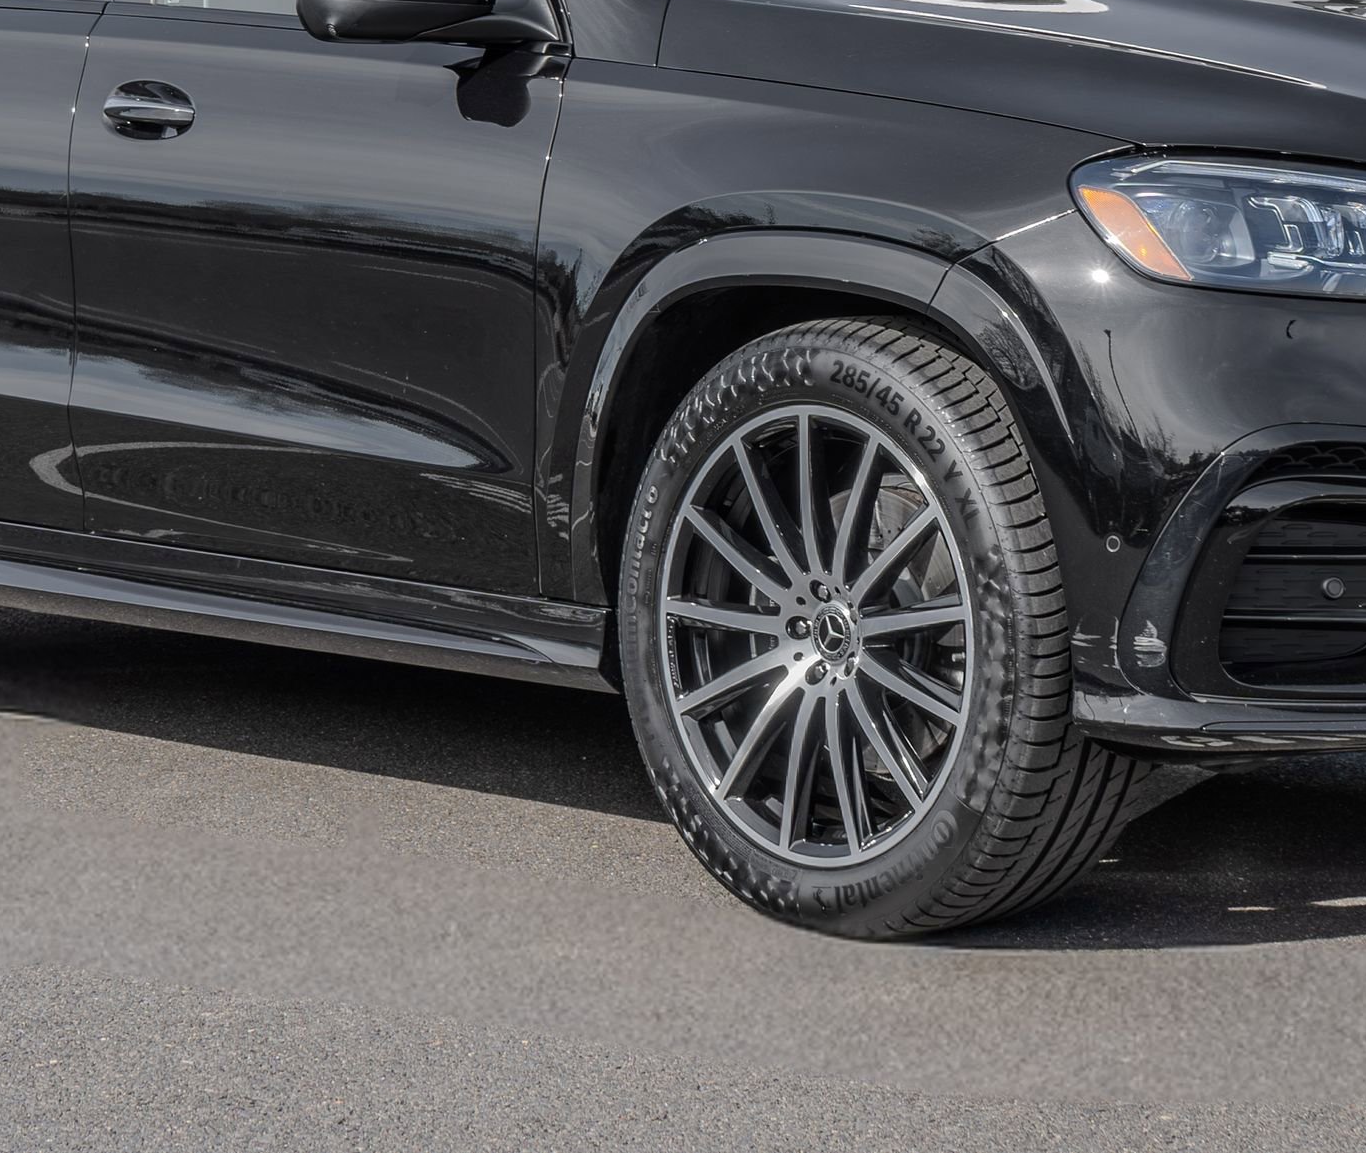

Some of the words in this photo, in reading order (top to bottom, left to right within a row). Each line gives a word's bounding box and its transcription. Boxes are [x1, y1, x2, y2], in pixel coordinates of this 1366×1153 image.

[829, 360, 905, 416] 285/45
[956, 487, 981, 530] XL
[834, 809, 959, 914] Continental
